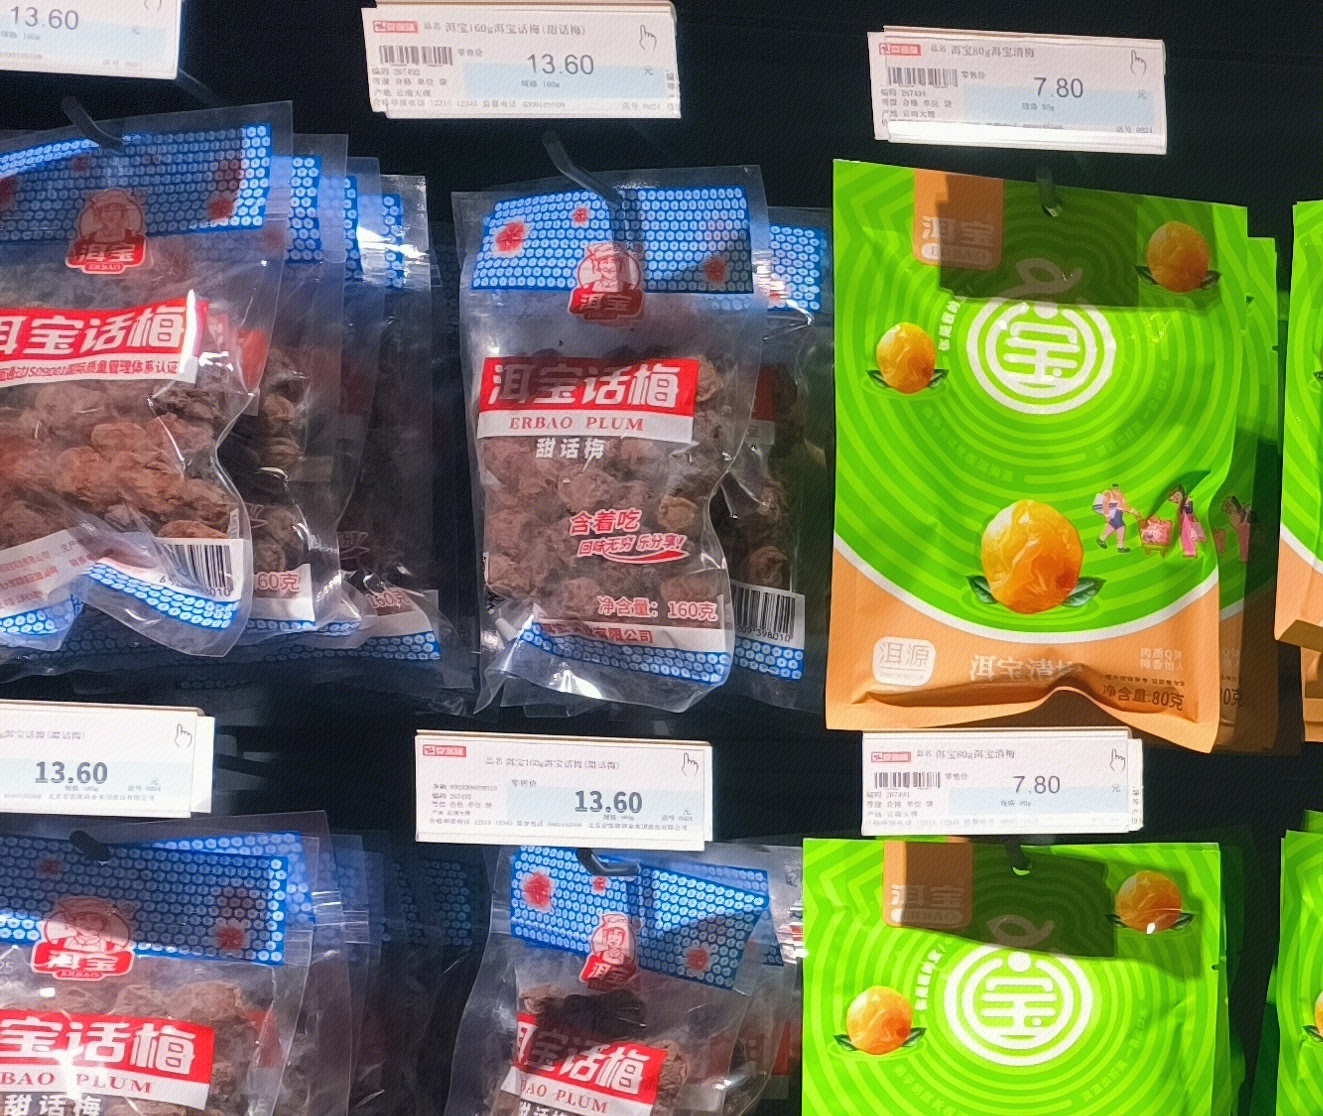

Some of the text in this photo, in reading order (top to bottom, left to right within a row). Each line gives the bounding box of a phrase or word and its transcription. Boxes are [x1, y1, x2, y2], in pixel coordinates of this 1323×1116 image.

[9, 6, 79, 31] 13.60
[527, 53, 595, 76] 13.60
[1033, 76, 1085, 99] 7.80
[922, 214, 996, 248] 洱宝
[488, 362, 680, 409] 洱宝话梅
[509, 416, 644, 432] ERBAO PLUM
[535, 437, 606, 461] 甜话梅
[569, 509, 642, 536] 含着吃
[878, 640, 931, 668] 洱源
[34, 760, 109, 785] 13.60
[1013, 773, 1062, 796] 7.80
[574, 789, 644, 815] 13.60
[890, 882, 966, 909] 洱宝
[75, 1073, 154, 1095] PLUM
[555, 1088, 609, 1115] PLUM
